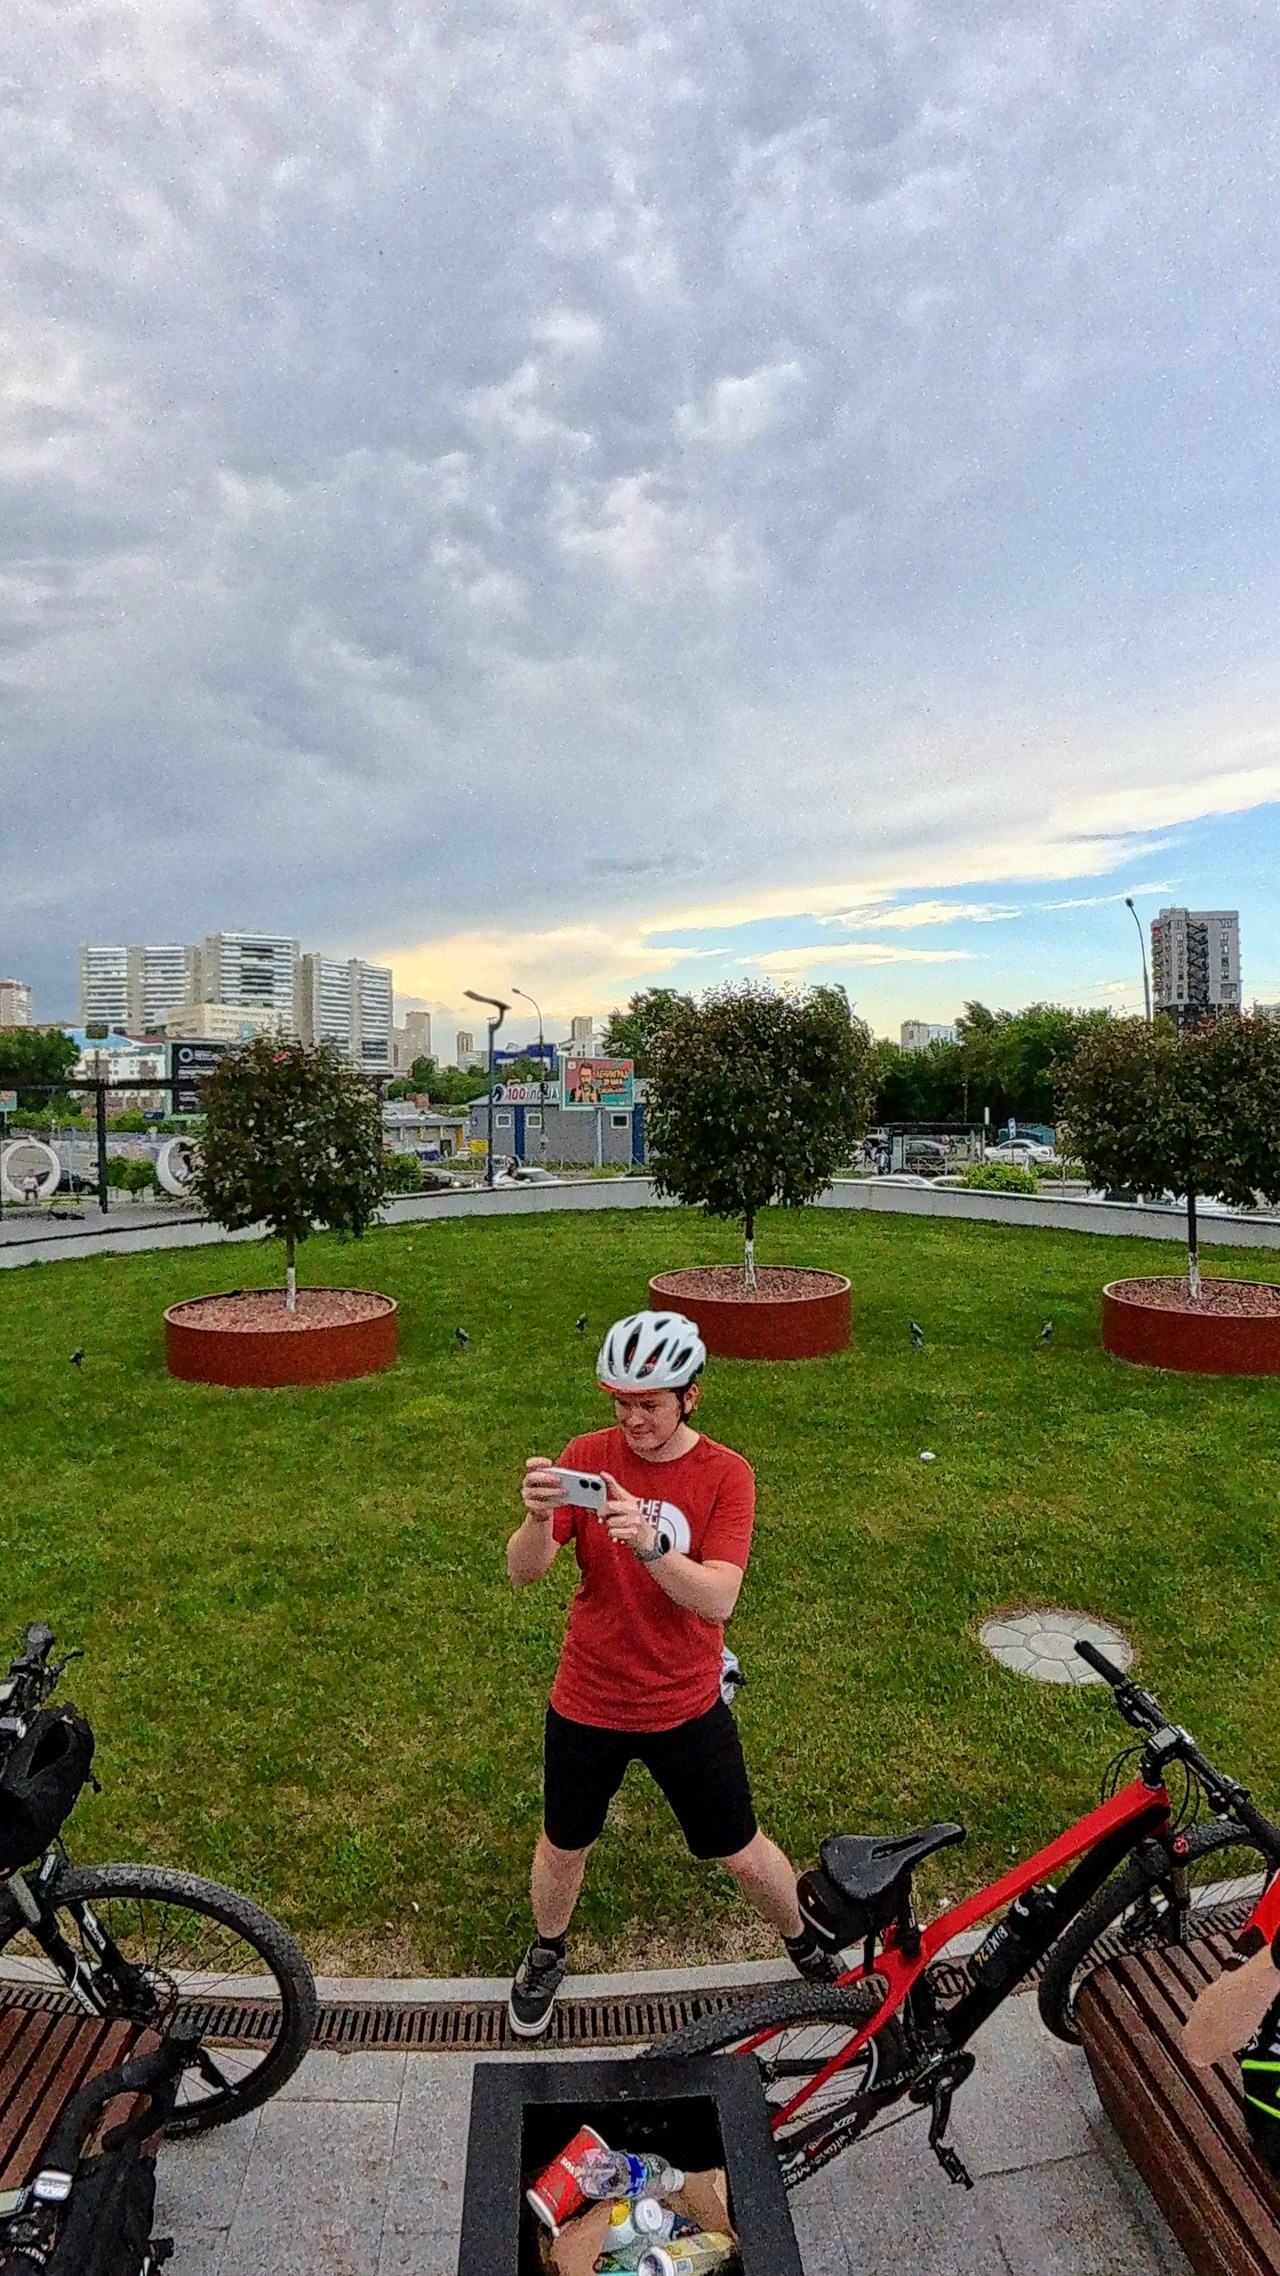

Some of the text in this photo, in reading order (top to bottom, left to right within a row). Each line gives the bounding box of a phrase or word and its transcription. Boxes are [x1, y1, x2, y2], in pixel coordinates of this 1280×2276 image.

[508, 1088, 526, 1101] 100
[637, 1498, 661, 1517] HE
[974, 1924, 1009, 1968] BIKE24
